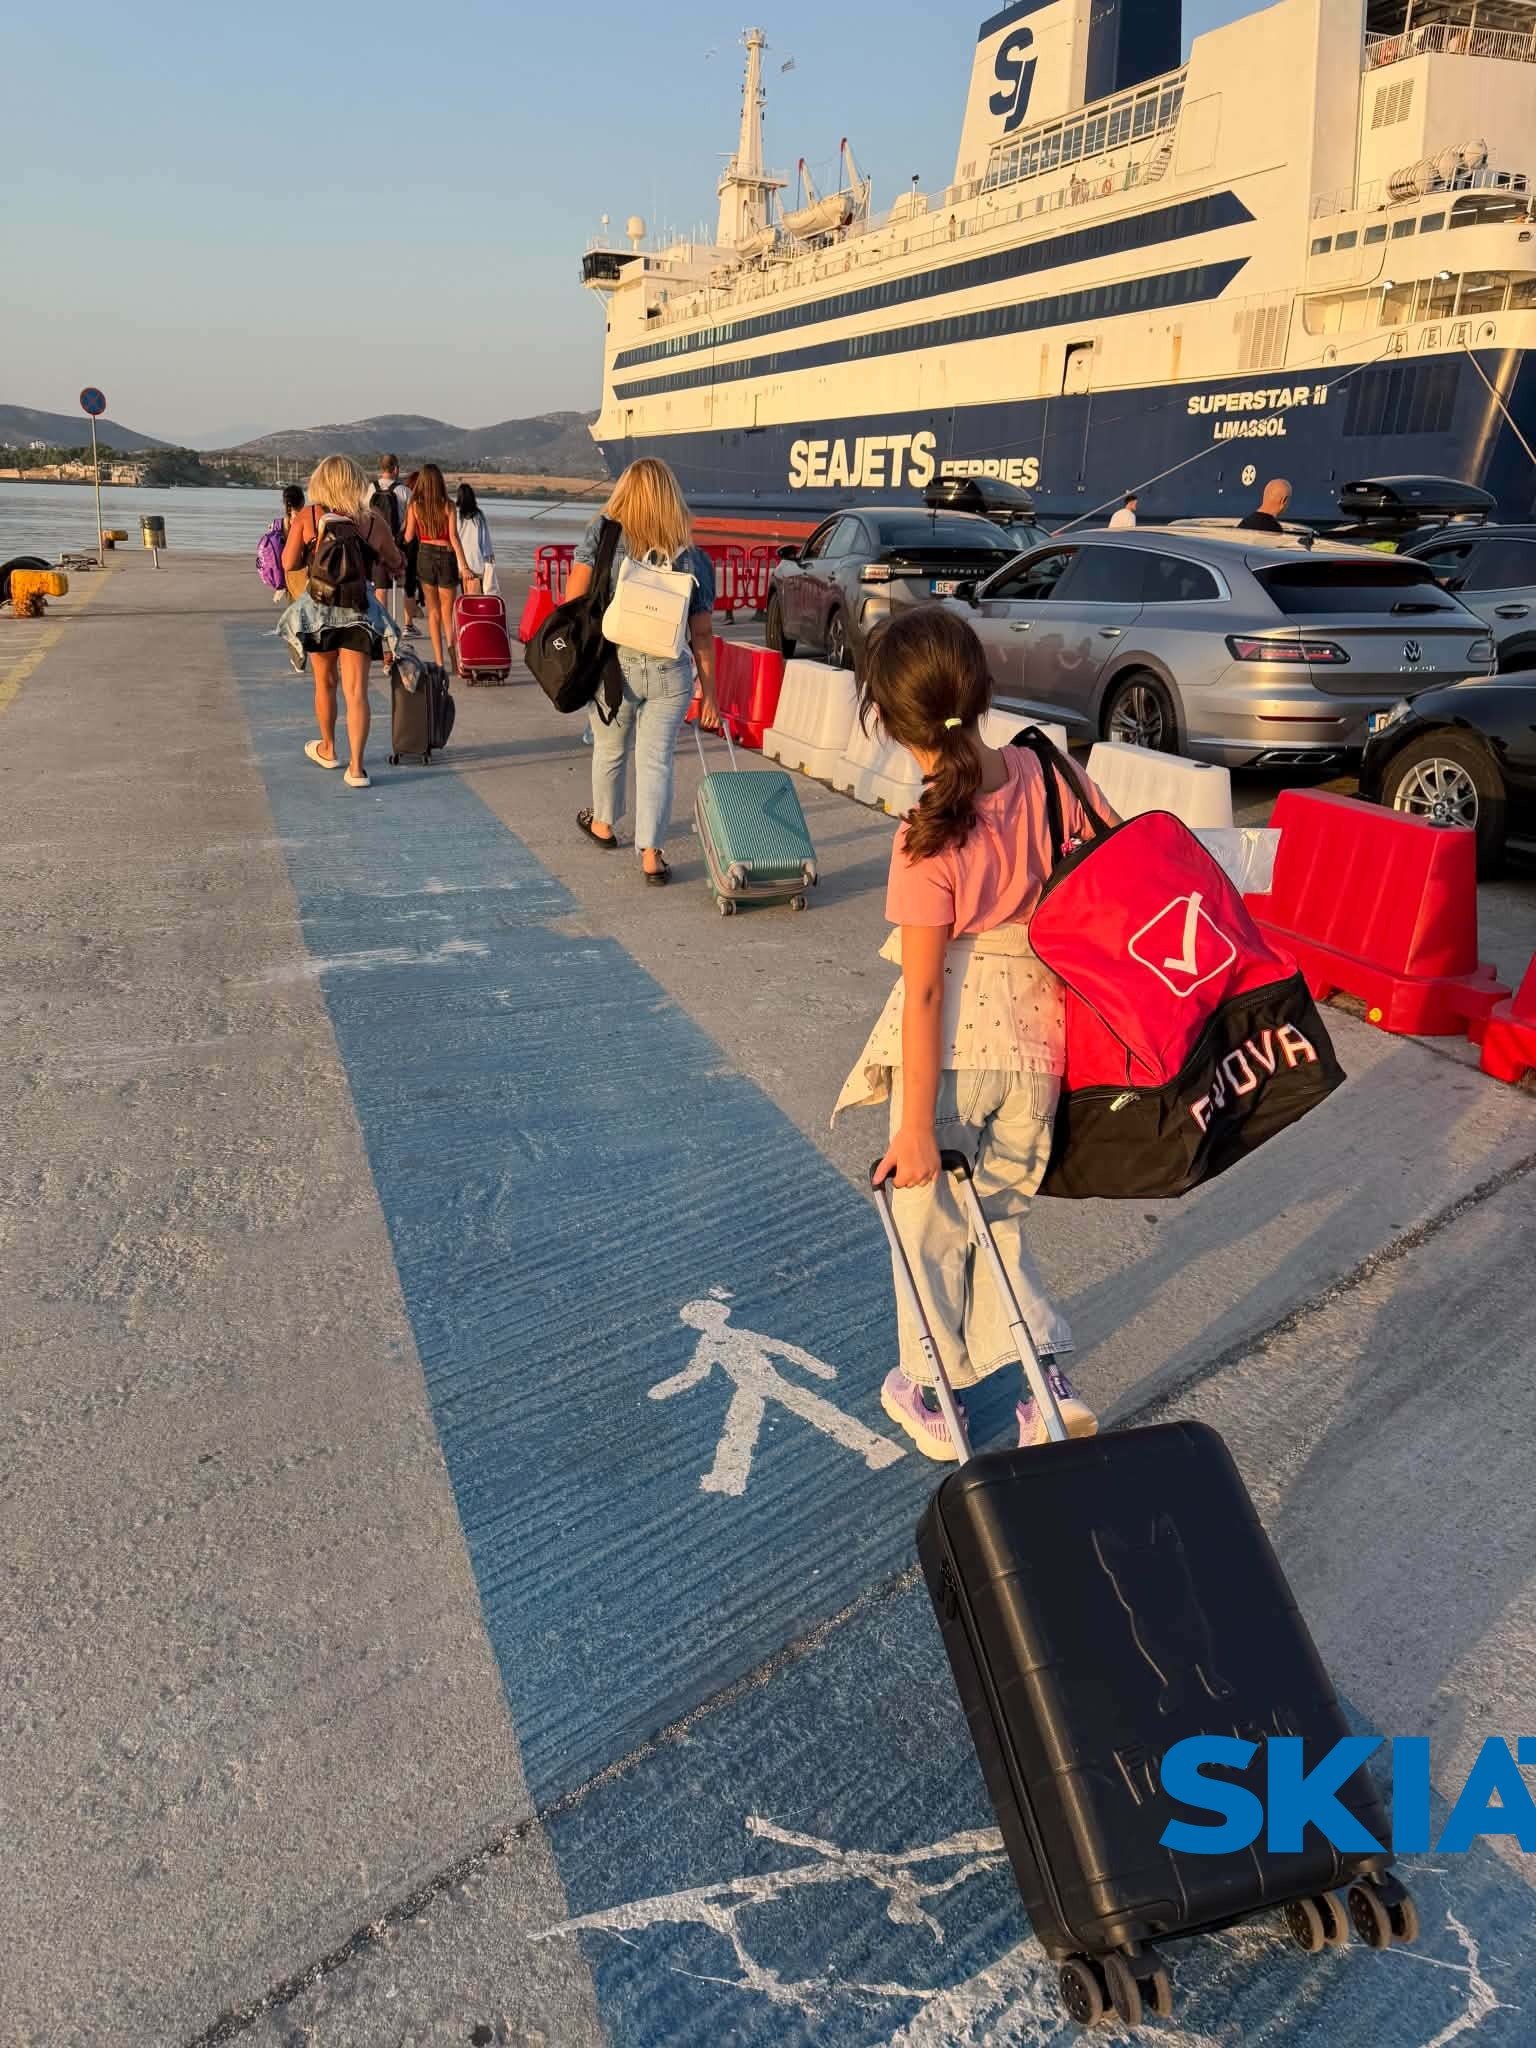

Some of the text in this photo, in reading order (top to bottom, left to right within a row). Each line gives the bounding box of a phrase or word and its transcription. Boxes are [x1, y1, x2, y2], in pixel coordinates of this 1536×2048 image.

[1187, 386, 1310, 415] SUPERSTAR
[1213, 417, 1287, 440] LIMASSOL
[788, 431, 937, 488] SEAJETS
